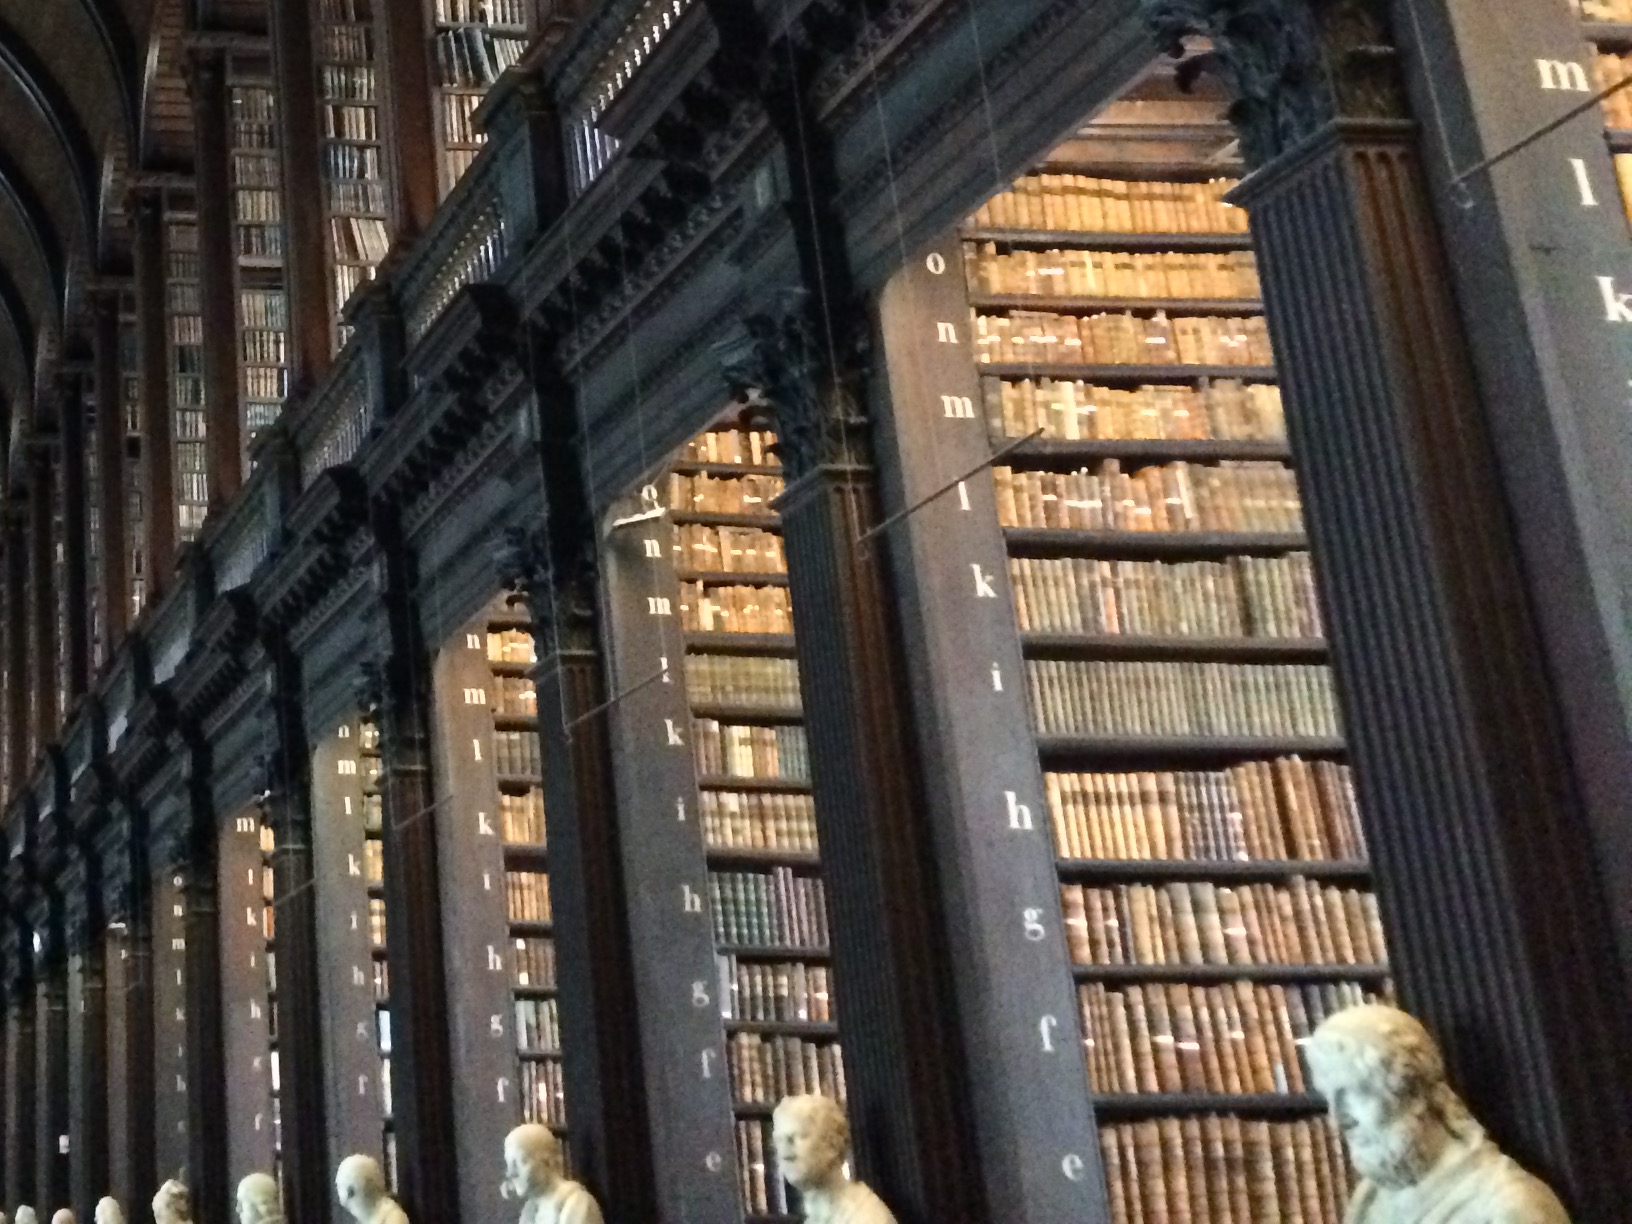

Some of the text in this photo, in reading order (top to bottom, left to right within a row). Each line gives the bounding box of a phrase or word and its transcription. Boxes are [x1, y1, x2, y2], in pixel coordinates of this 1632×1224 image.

[1536, 58, 1591, 92] m
[926, 253, 946, 275] o
[1597, 276, 1632, 322] k
[936, 321, 959, 344] n
[940, 394, 975, 419] m
[641, 484, 658, 501] o
[643, 538, 662, 558] n
[971, 563, 997, 598] k
[647, 596, 672, 616] m
[466, 633, 481, 650] n
[463, 687, 487, 705] m
[337, 725, 350, 739] n
[664, 718, 684, 746] k
[337, 759, 357, 775] m
[1004, 790, 1034, 830] h
[236, 817, 255, 833] m
[478, 811, 494, 836] k
[348, 853, 361, 876] k
[682, 884, 702, 913] h
[246, 906, 257, 926] k
[1023, 907, 1046, 941] g
[171, 938, 186, 951] m
[487, 945, 503, 971] h
[352, 965, 365, 986] h
[250, 1000, 261, 1019] h
[1039, 1015, 1057, 1052] f
[701, 1049, 716, 1078] f
[496, 1077, 509, 1103] f
[705, 1152, 722, 1172] e
[1061, 1154, 1084, 1180] e
